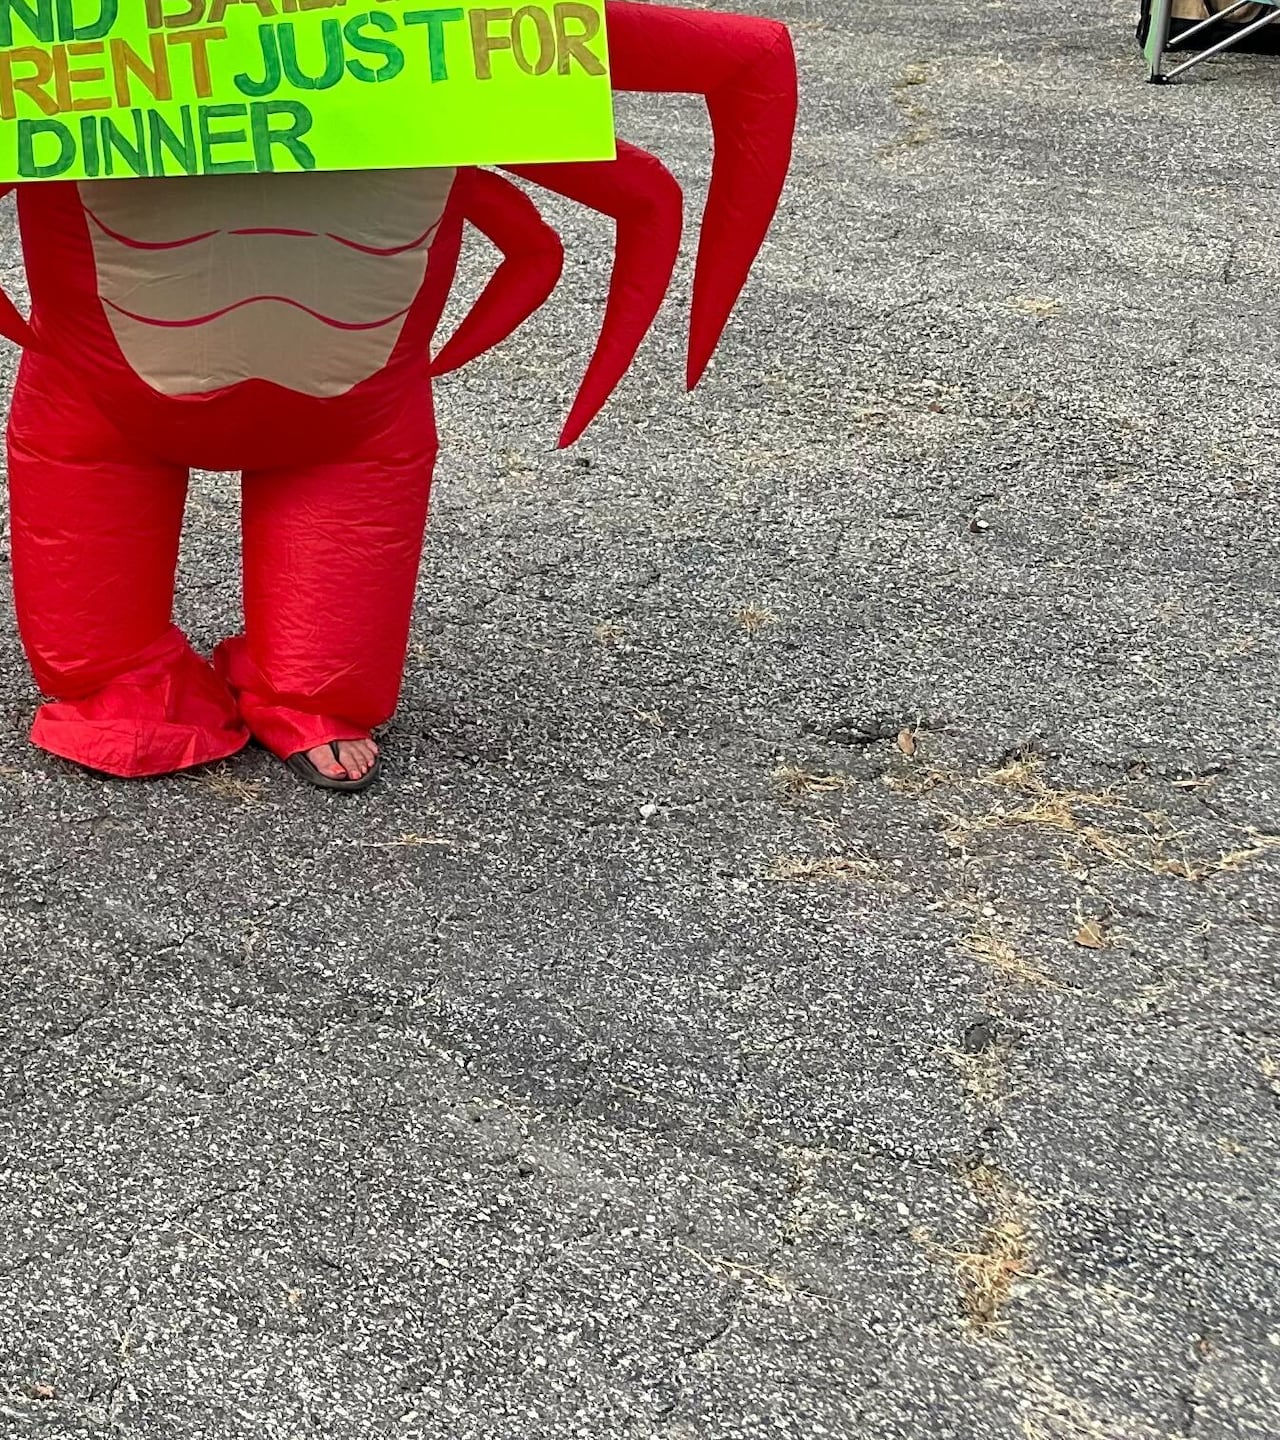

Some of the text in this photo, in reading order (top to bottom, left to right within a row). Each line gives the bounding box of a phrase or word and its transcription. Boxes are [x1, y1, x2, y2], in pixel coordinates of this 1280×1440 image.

[232, 6, 464, 98] JUST
[470, 1, 606, 81] FOR
[16, 98, 316, 179] DINNER
